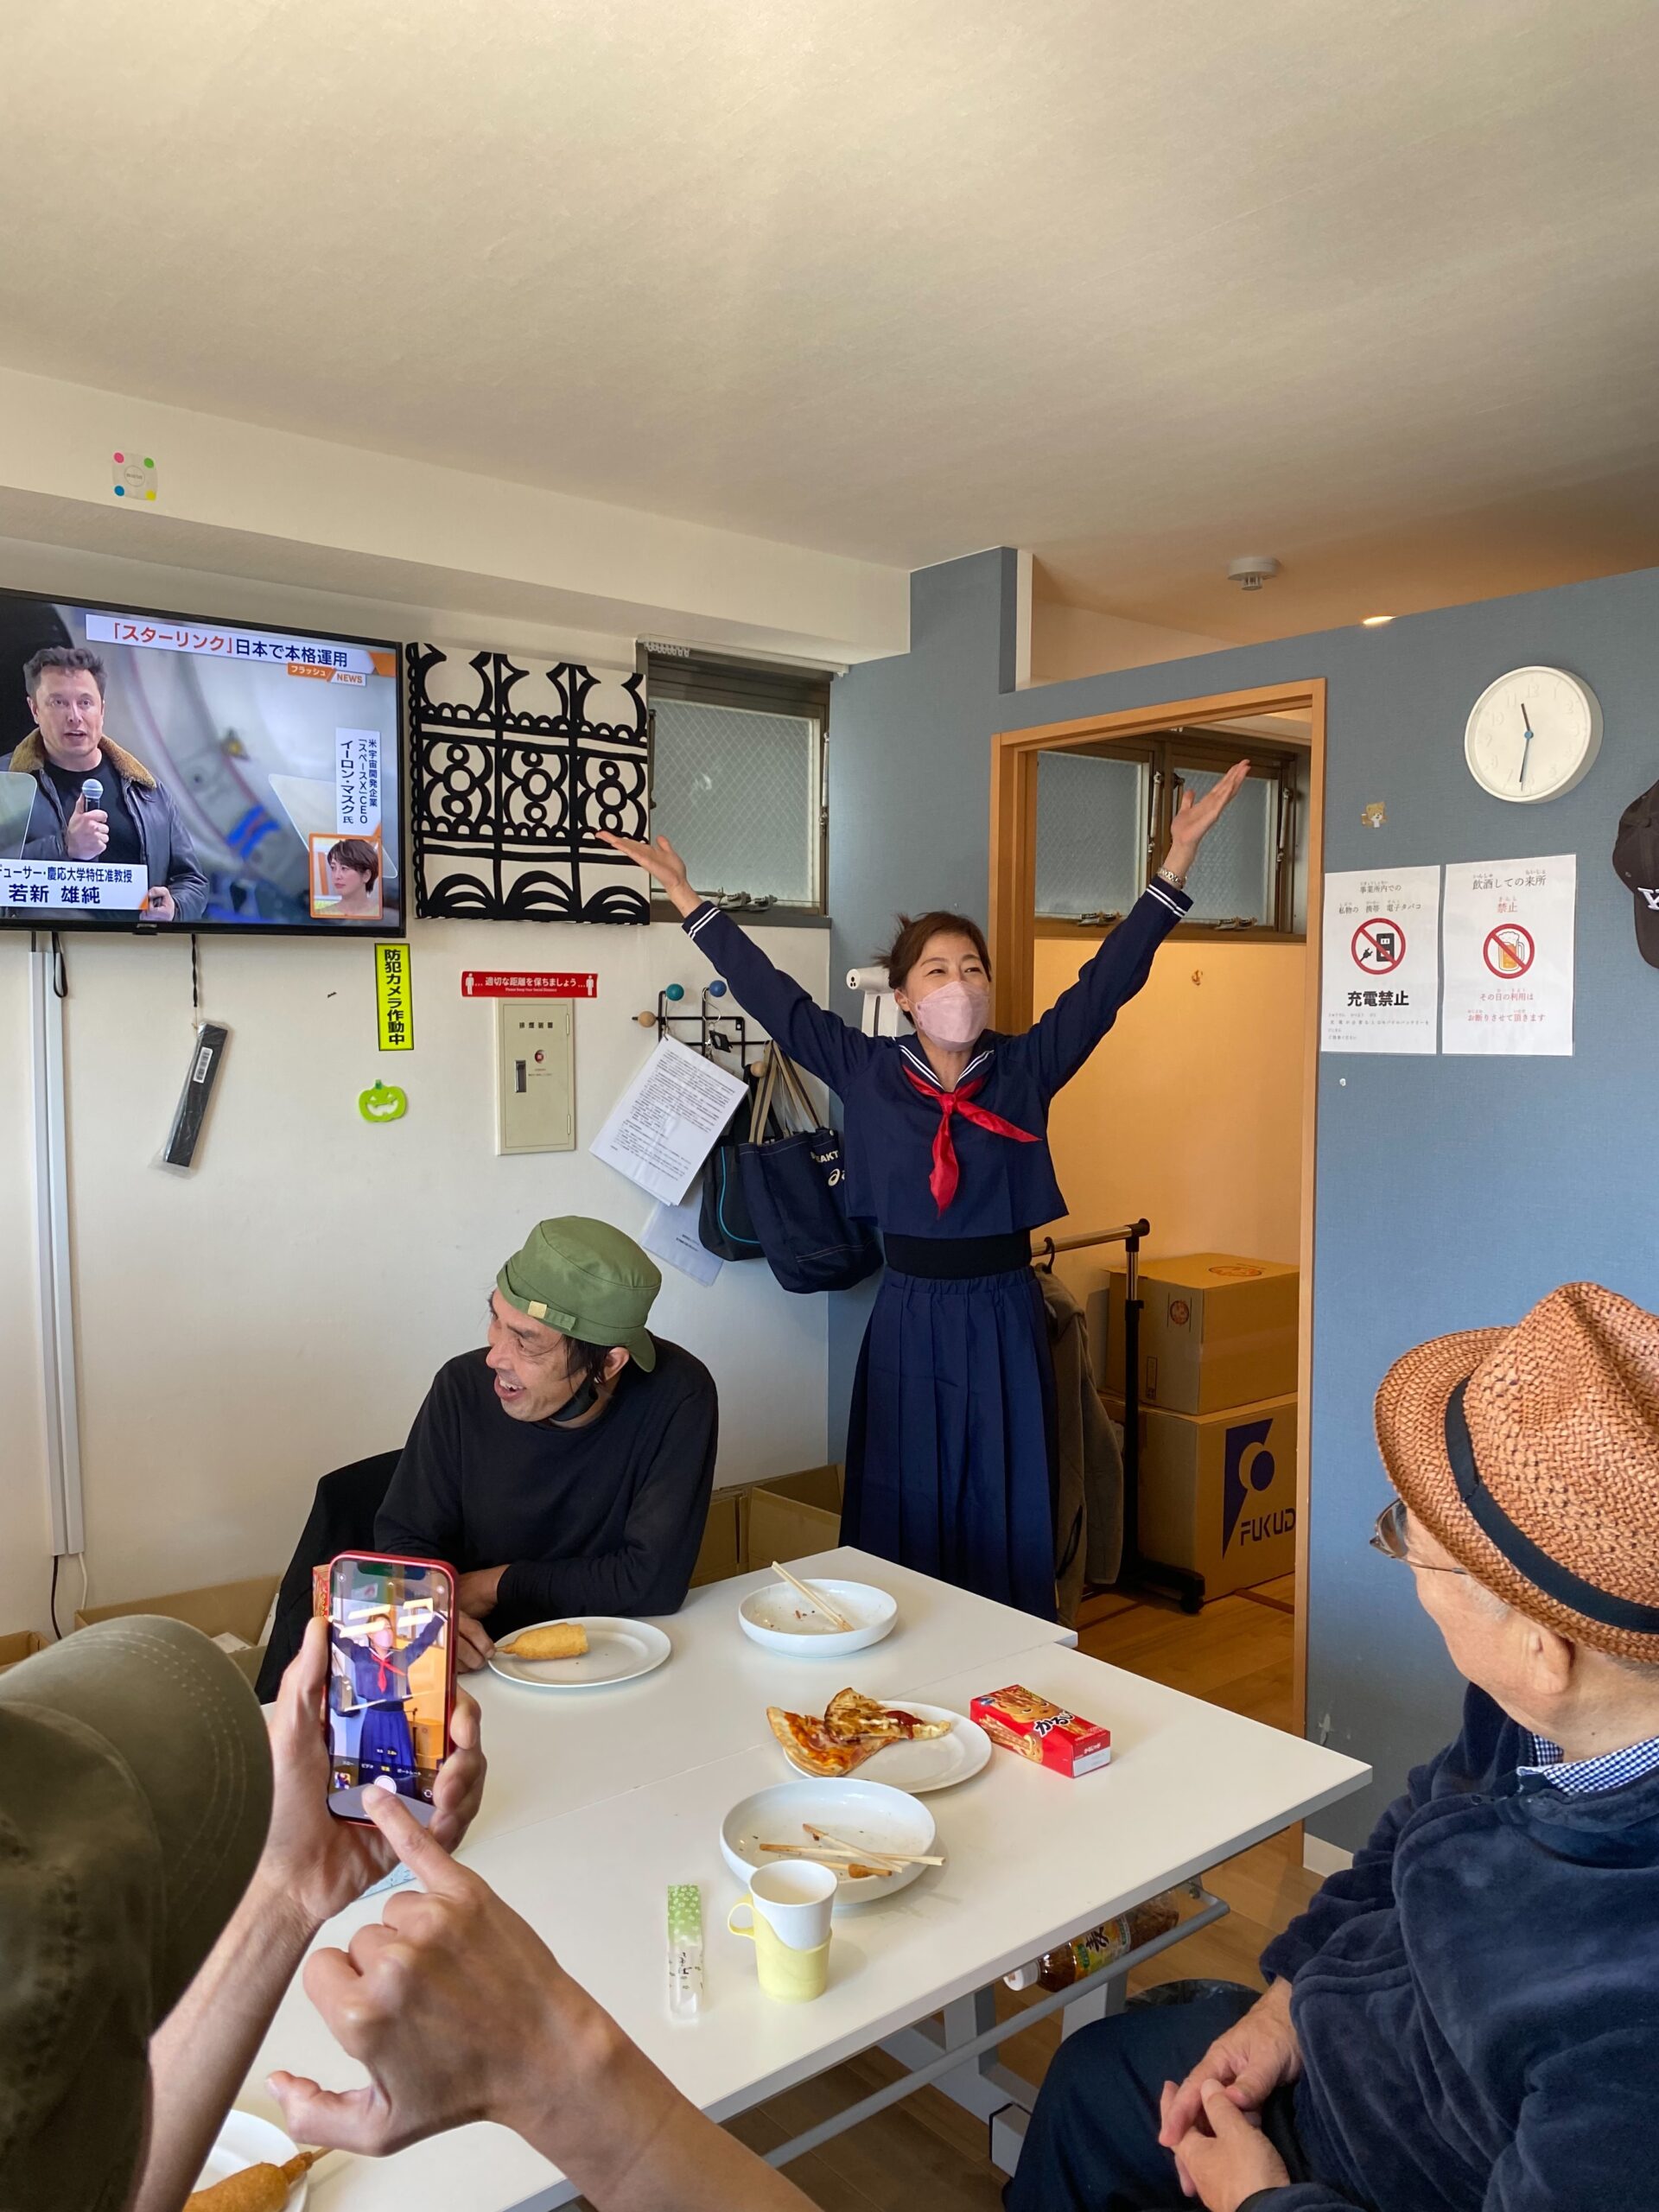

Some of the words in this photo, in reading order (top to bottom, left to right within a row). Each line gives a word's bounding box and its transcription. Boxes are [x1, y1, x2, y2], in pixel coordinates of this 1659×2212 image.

[113, 622, 348, 668] 「スターリンク」日本で本格運用
[290, 665, 327, 677] フラッシュ
[337, 673, 363, 683] NEWS
[358, 738, 368, 824] 「スペースX」CEO
[368, 739, 378, 808] 米宇宙開発企業
[0, 865, 133, 883] ューサー・慶応大学特任准教授
[1472, 874, 1547, 891] 飲酒しての来所
[9, 883, 49, 904] 若新
[60, 885, 101, 905] 雄純
[1497, 901, 1518, 913] 禁止
[485, 976, 577, 987] 適切な距離を保ちましょう
[385, 949, 405, 1046] 防犯カメラ作動中
[1347, 990, 1410, 1007] 充電禁止
